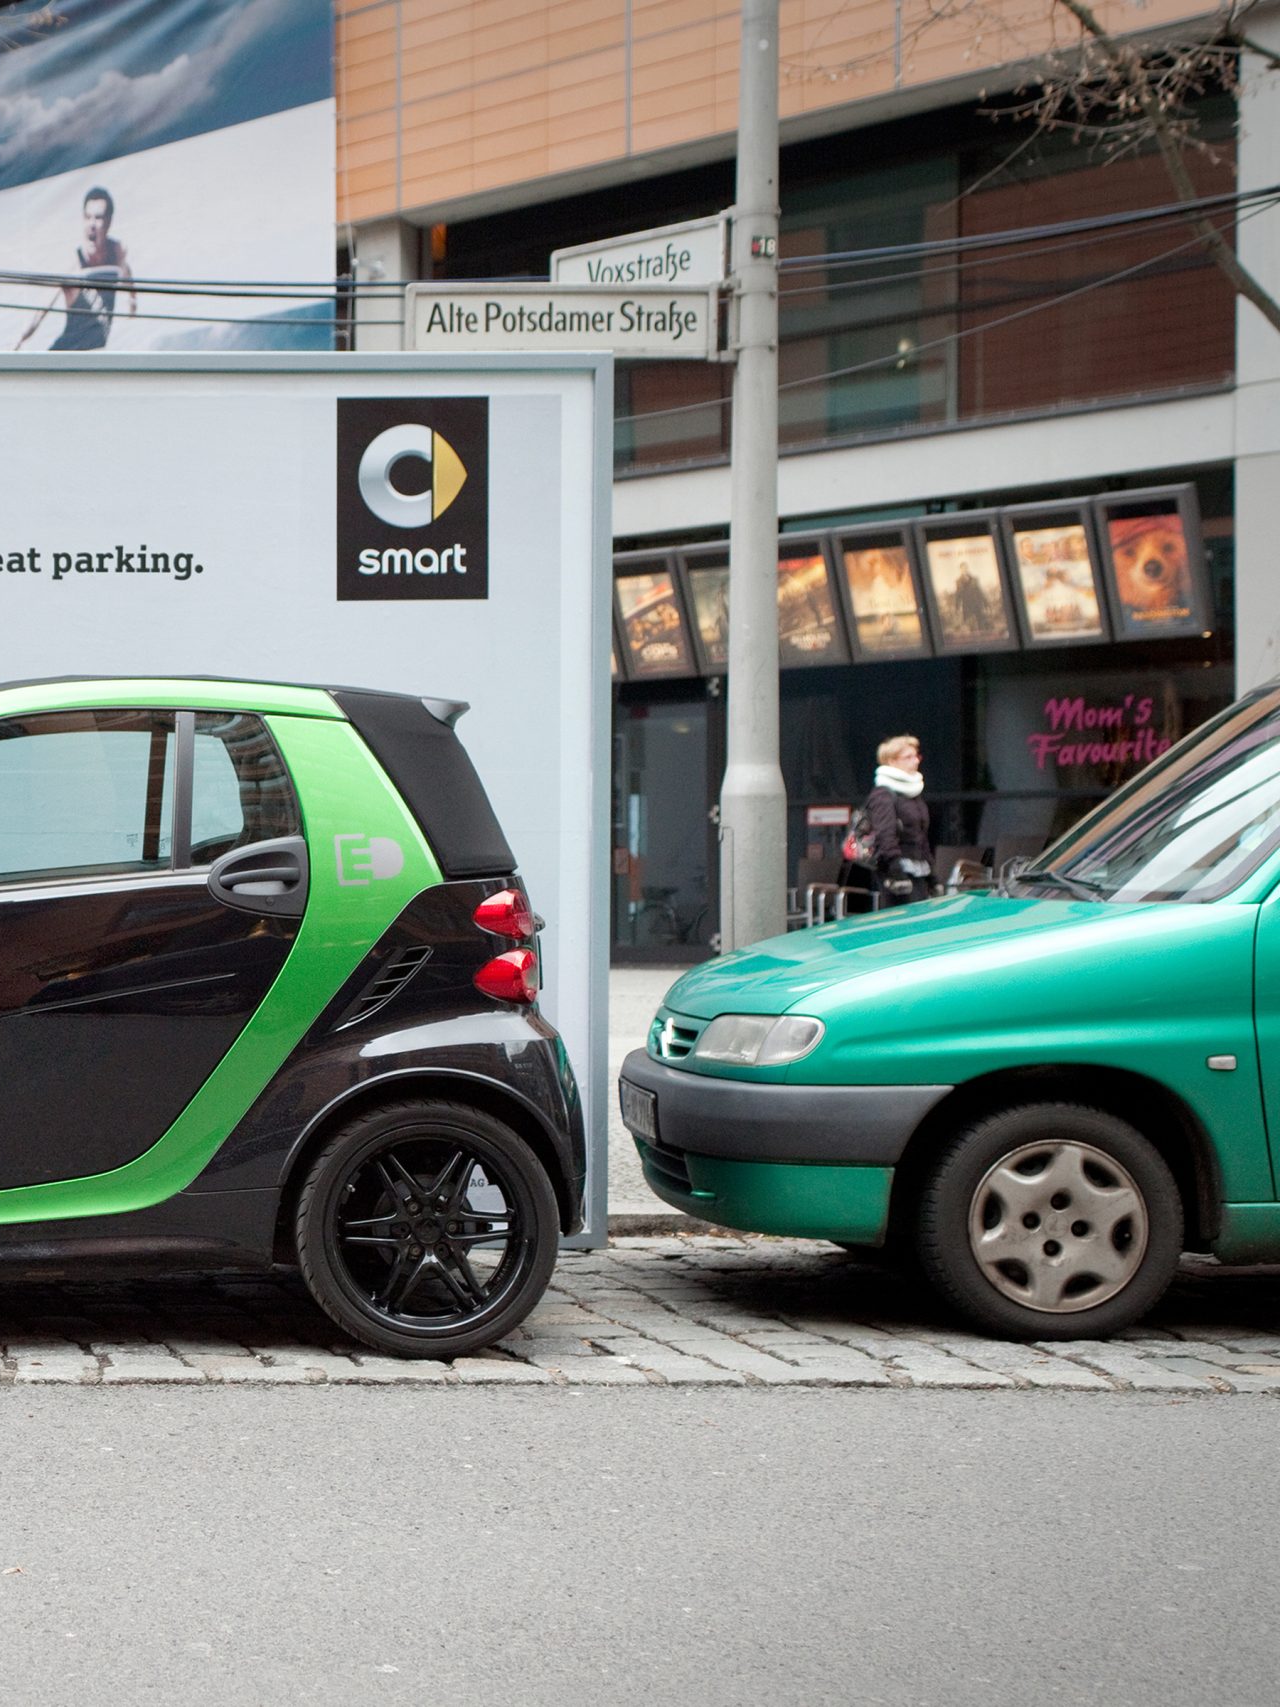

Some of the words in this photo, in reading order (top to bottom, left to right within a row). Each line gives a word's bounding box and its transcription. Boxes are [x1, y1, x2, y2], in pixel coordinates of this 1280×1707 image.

[587, 243, 691, 283] Voxstraße
[426, 302, 478, 333] Alte
[485, 301, 615, 333] Potsdamer
[620, 300, 698, 340] Straße
[51, 545, 205, 581] parking.
[358, 543, 468, 575] smart
[1044, 694, 1153, 731] Mom's
[1026, 728, 1172, 770] Favourite
